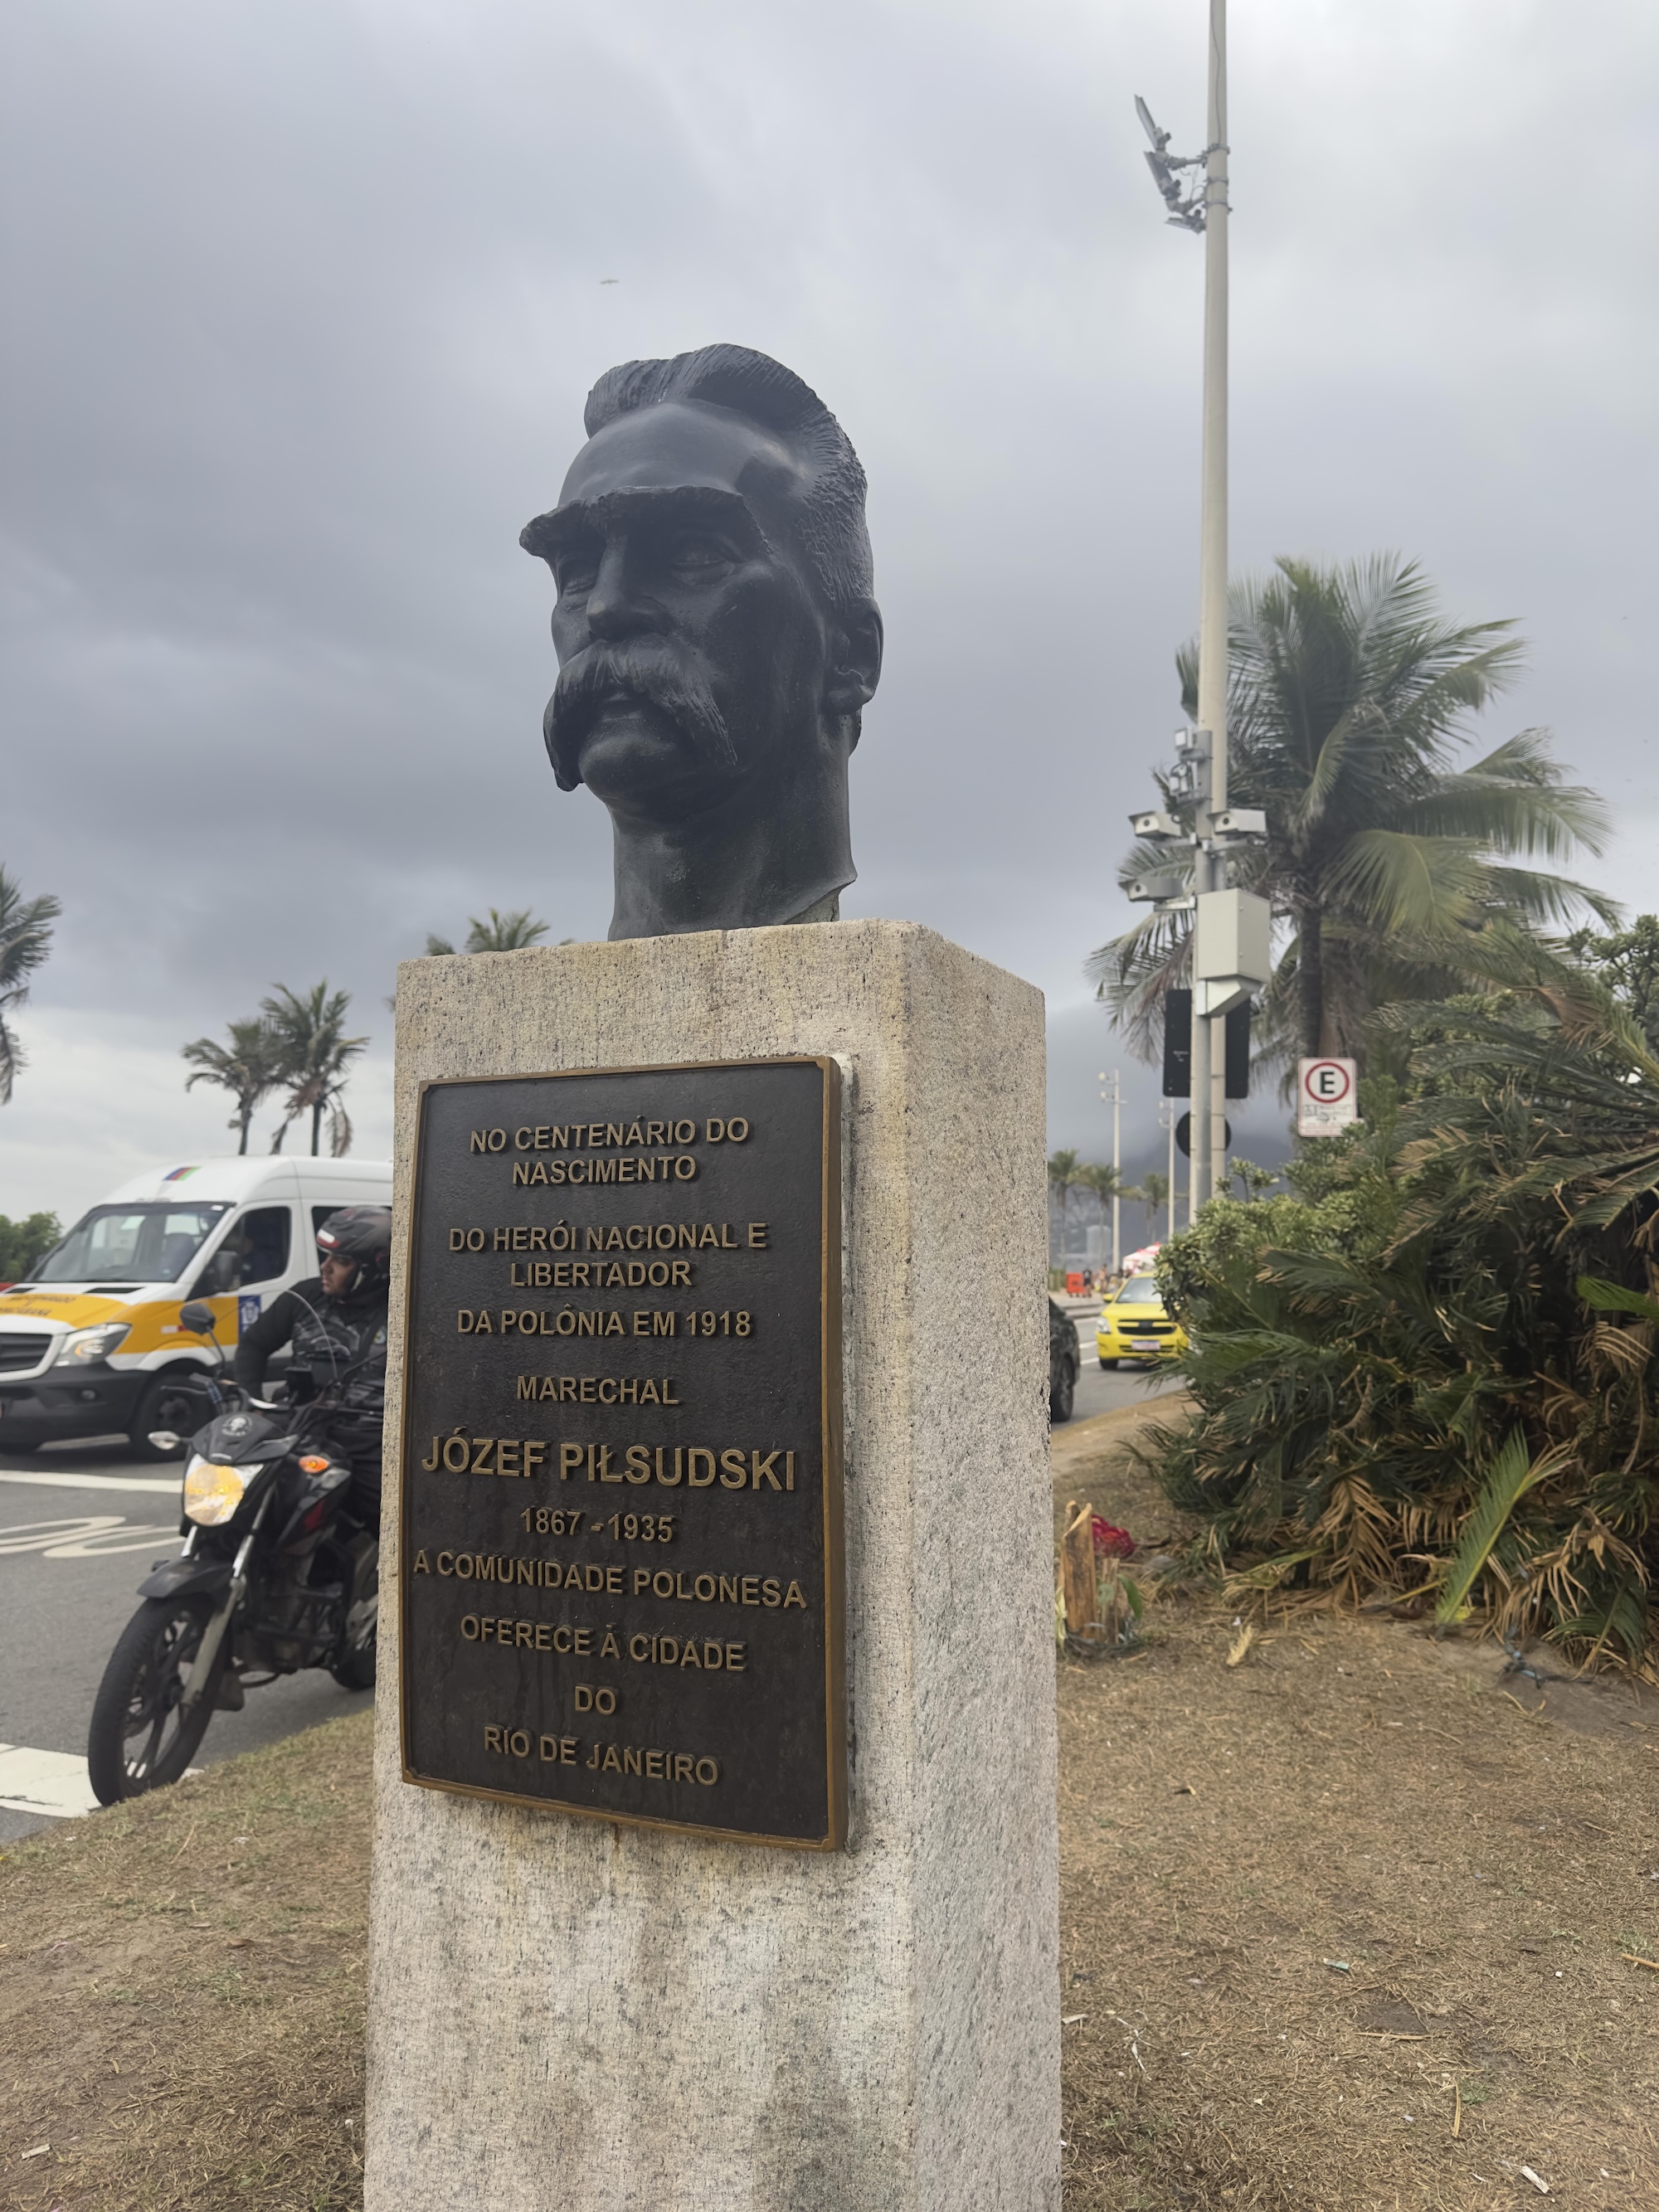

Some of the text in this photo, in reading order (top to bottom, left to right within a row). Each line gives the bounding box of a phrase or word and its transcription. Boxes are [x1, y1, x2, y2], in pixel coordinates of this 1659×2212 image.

[1320, 1072, 1335, 1094] E
[470, 1116, 749, 1153] NO CENTENÁRIO DO
[512, 1156, 697, 1186] NASCIMENTO
[450, 1220, 767, 1252] DO HERÓI NACIONAL E
[510, 1261, 693, 1287] LIBERTADOR
[457, 1310, 494, 1334] DA
[633, 1311, 675, 1336] EM
[685, 1310, 752, 1337] 1918
[517, 1375, 680, 1405] MARECHAL
[421, 1427, 795, 1491] JÓZEF PIŁSUDSKI
[520, 1507, 581, 1536] 1867
[608, 1514, 674, 1543] 1935
[414, 1550, 806, 1609] A COMUNIDADE POLONESA
[460, 1614, 591, 1656] OFERECE
[629, 1635, 746, 1672] CIDADE
[574, 1686, 616, 1714] DO
[484, 1726, 718, 1786] RIO DE JANEIRO
